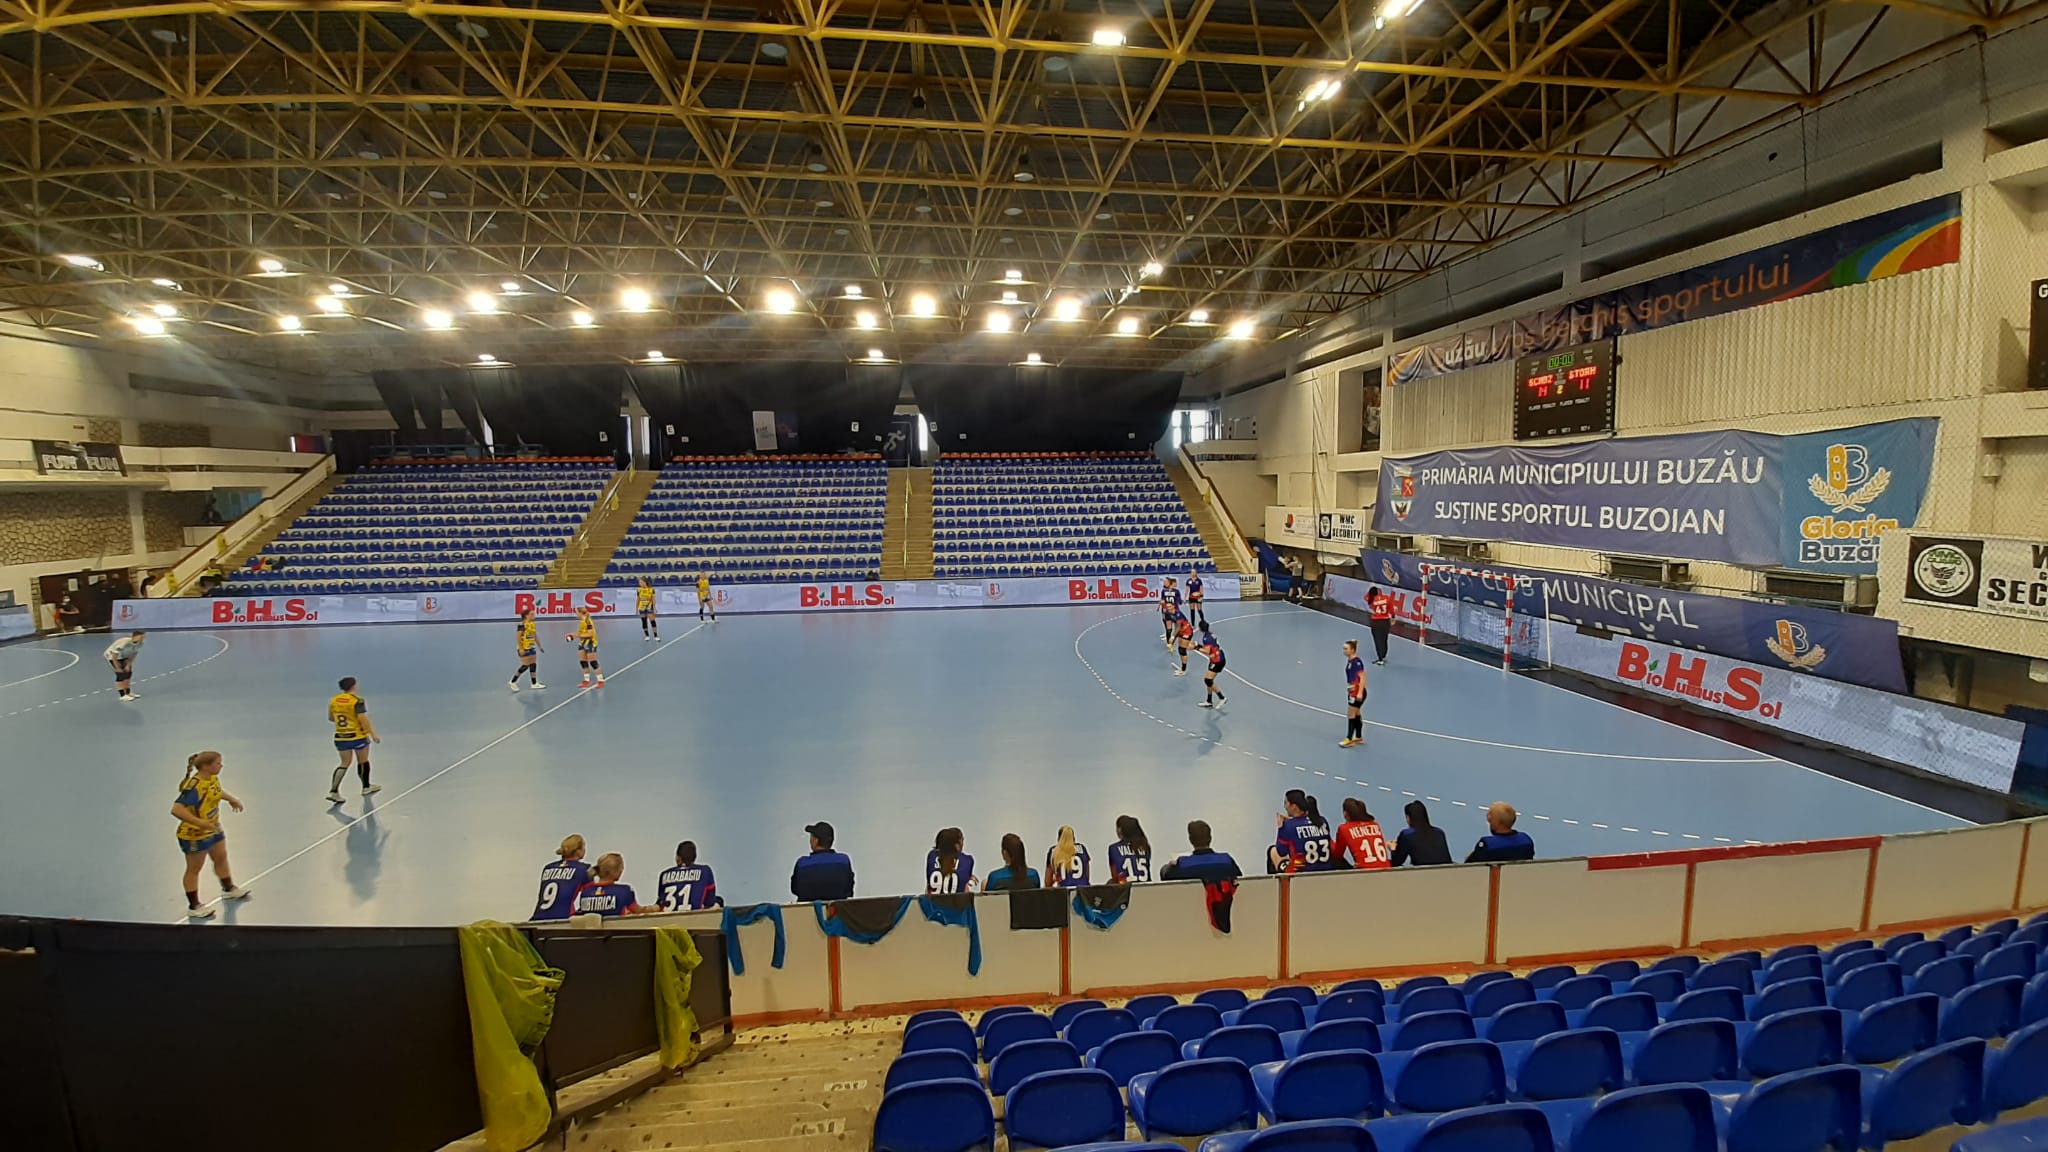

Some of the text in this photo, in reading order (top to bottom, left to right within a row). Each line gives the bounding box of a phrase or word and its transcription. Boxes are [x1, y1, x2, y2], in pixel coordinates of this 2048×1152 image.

[1637, 253, 1791, 323] sportului
[1422, 449, 1765, 486] PRIMĂRIA MUNICIPIULUI BUZĂU
[1434, 501, 1726, 536] SUSȚINE SPORTUL BUZOIAN
[1799, 538, 1880, 563] Buză
[1543, 578, 1699, 629] MUNICIPAL
[337, 715, 348, 728] 8
[1304, 839, 1331, 864] 83
[1360, 837, 1387, 864] 16
[930, 871, 958, 895] 90
[1122, 857, 1148, 882] 15
[541, 882, 559, 910] 9
[664, 884, 692, 912] 31
